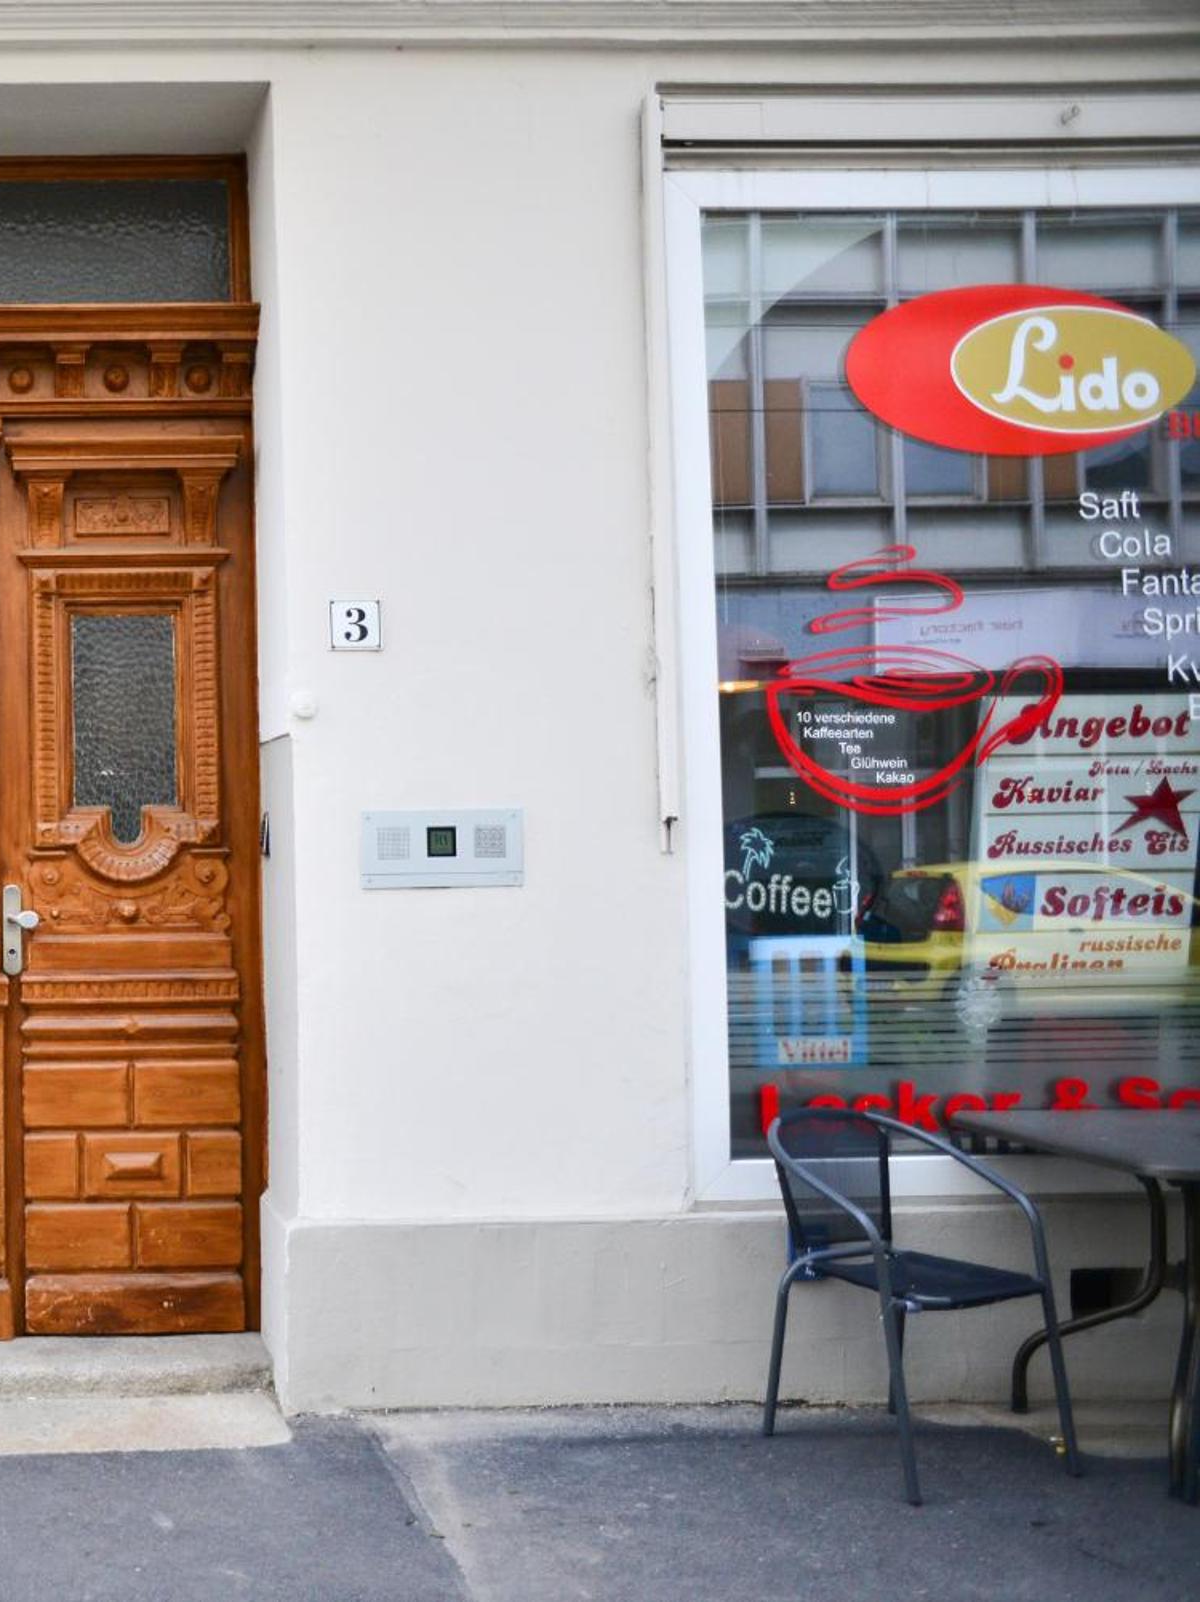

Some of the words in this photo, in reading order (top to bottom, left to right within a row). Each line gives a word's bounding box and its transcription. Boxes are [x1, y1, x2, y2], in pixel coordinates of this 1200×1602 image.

[990, 316, 1160, 412] Lido
[1079, 491, 1140, 519] Saft
[1100, 528, 1171, 558] Cola
[344, 608, 369, 642] 3
[796, 711, 812, 723] 10
[814, 711, 896, 724] verschiedene
[803, 726, 874, 739] Kaffeearten
[838, 742, 862, 755] Tee
[850, 756, 908, 769] Glühwein
[876, 771, 916, 784] Kakao
[992, 776, 1104, 809] Kaviar
[987, 829, 1133, 859] Russisches
[1144, 830, 1190, 856] Eis
[724, 869, 833, 919] Coffee
[1040, 884, 1186, 922] Softeis
[1079, 933, 1182, 953] russische
